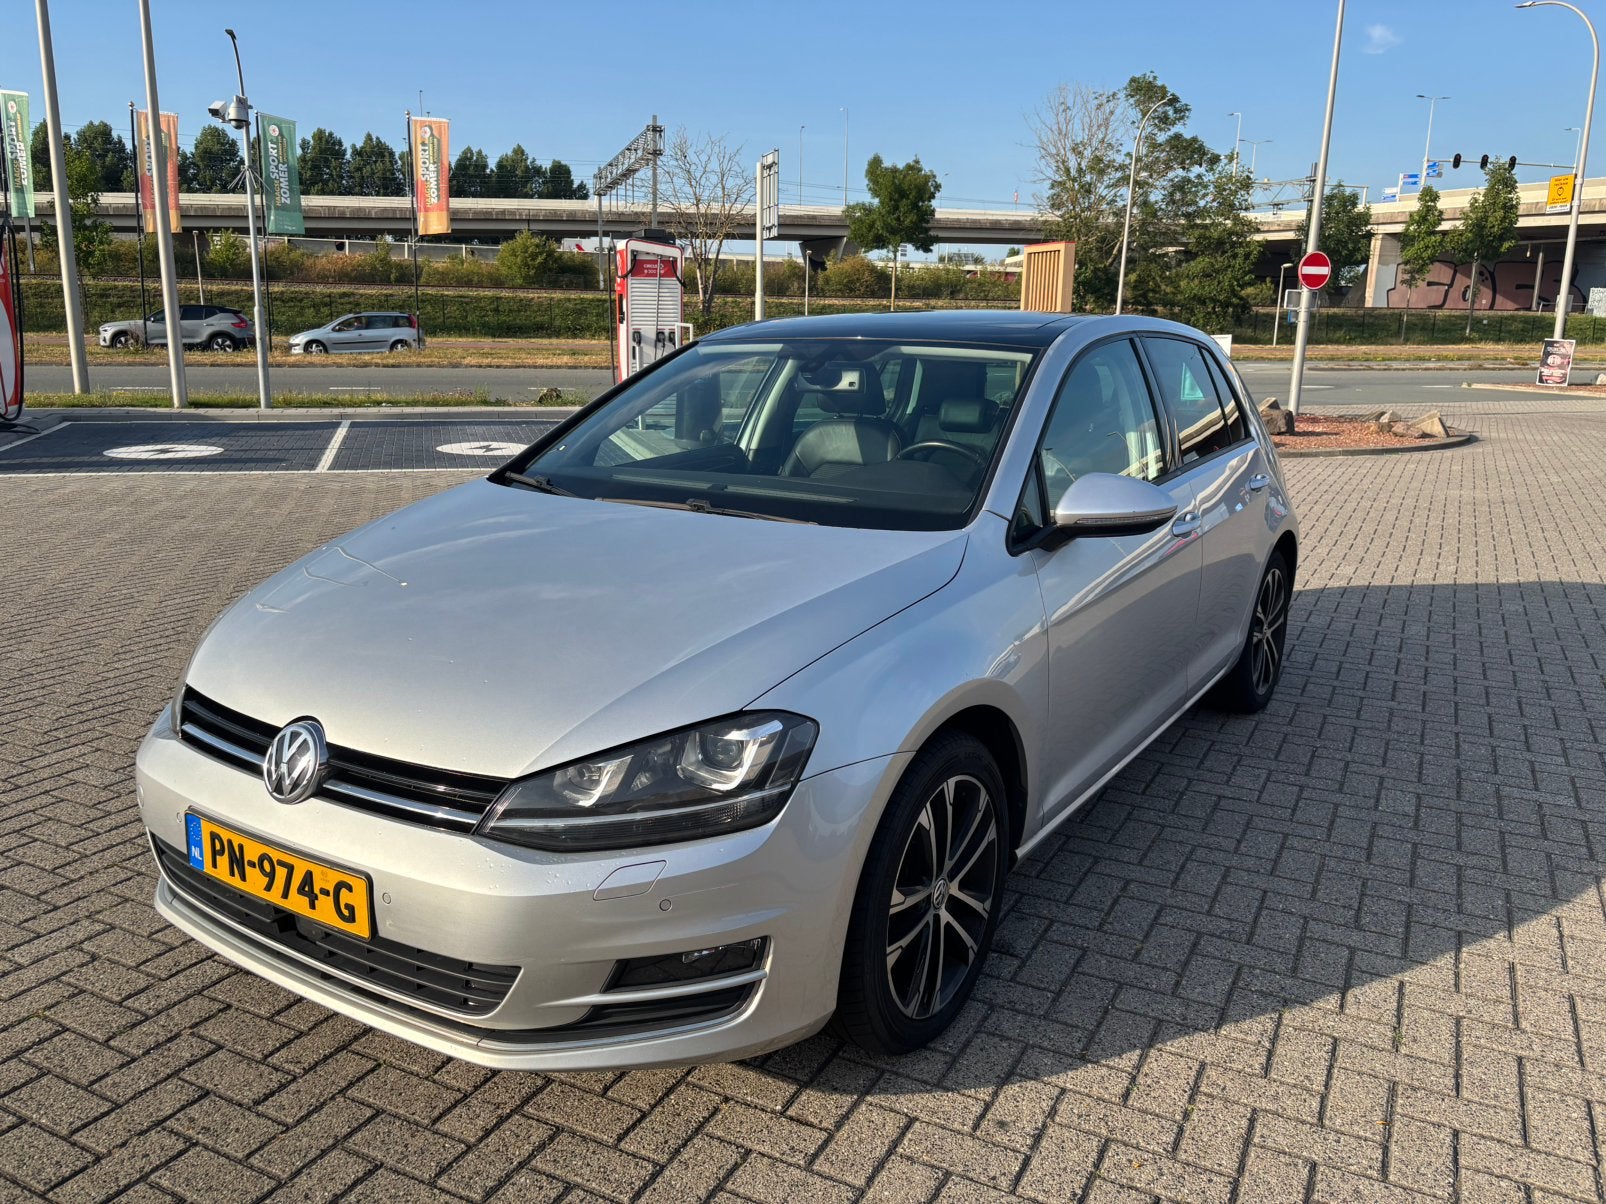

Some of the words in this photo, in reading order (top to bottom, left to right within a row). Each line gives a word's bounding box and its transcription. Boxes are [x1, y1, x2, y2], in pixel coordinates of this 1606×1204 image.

[8, 121, 18, 160] SPORT
[17, 142, 27, 186] ZOMER
[268, 142, 280, 180] SPORT
[420, 146, 430, 181] SPORT
[279, 163, 290, 205] ZOMER
[429, 163, 438, 204] ZOMER
[191, 845, 202, 860] NL
[209, 830, 356, 924] PN-974-G
